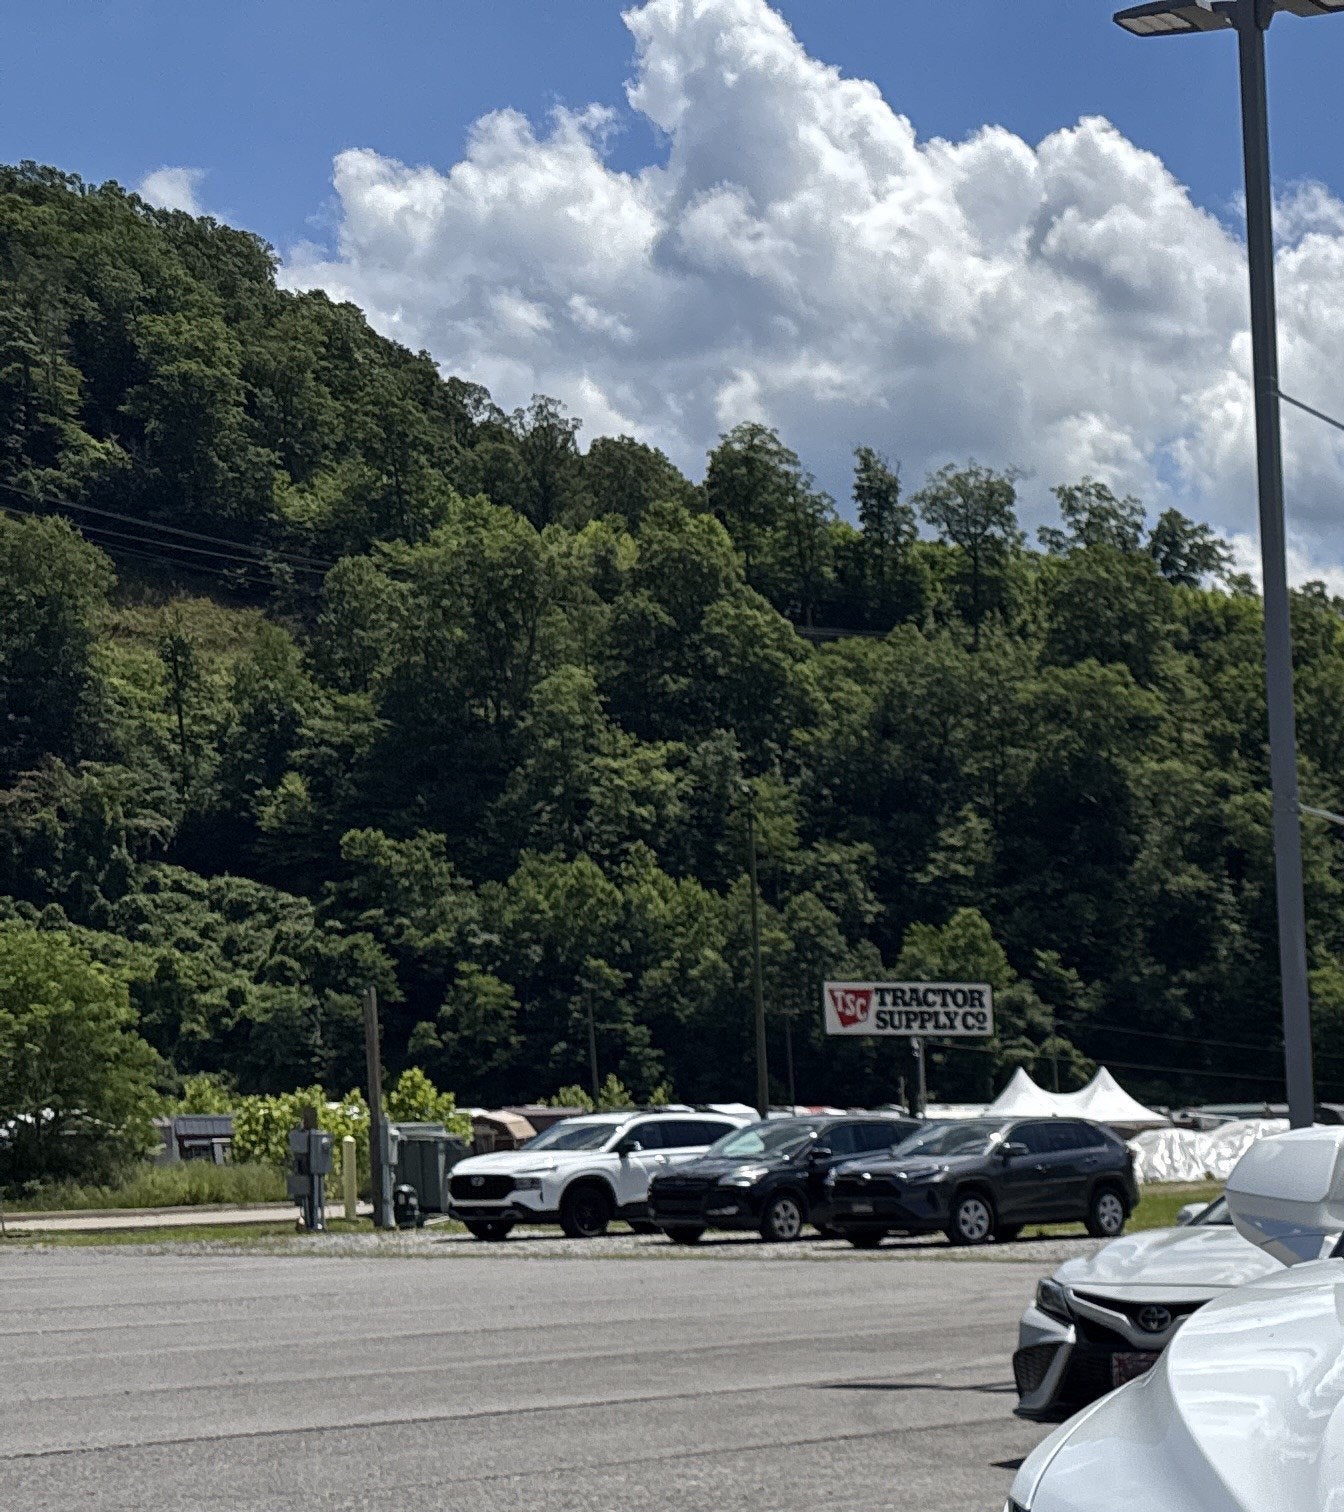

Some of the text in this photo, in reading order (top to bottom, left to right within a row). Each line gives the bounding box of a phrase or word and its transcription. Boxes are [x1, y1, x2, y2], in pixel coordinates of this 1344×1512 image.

[833, 990, 868, 1022] TSC
[874, 987, 986, 1009] TRACTOR
[875, 1010, 959, 1031] SUPPLY
